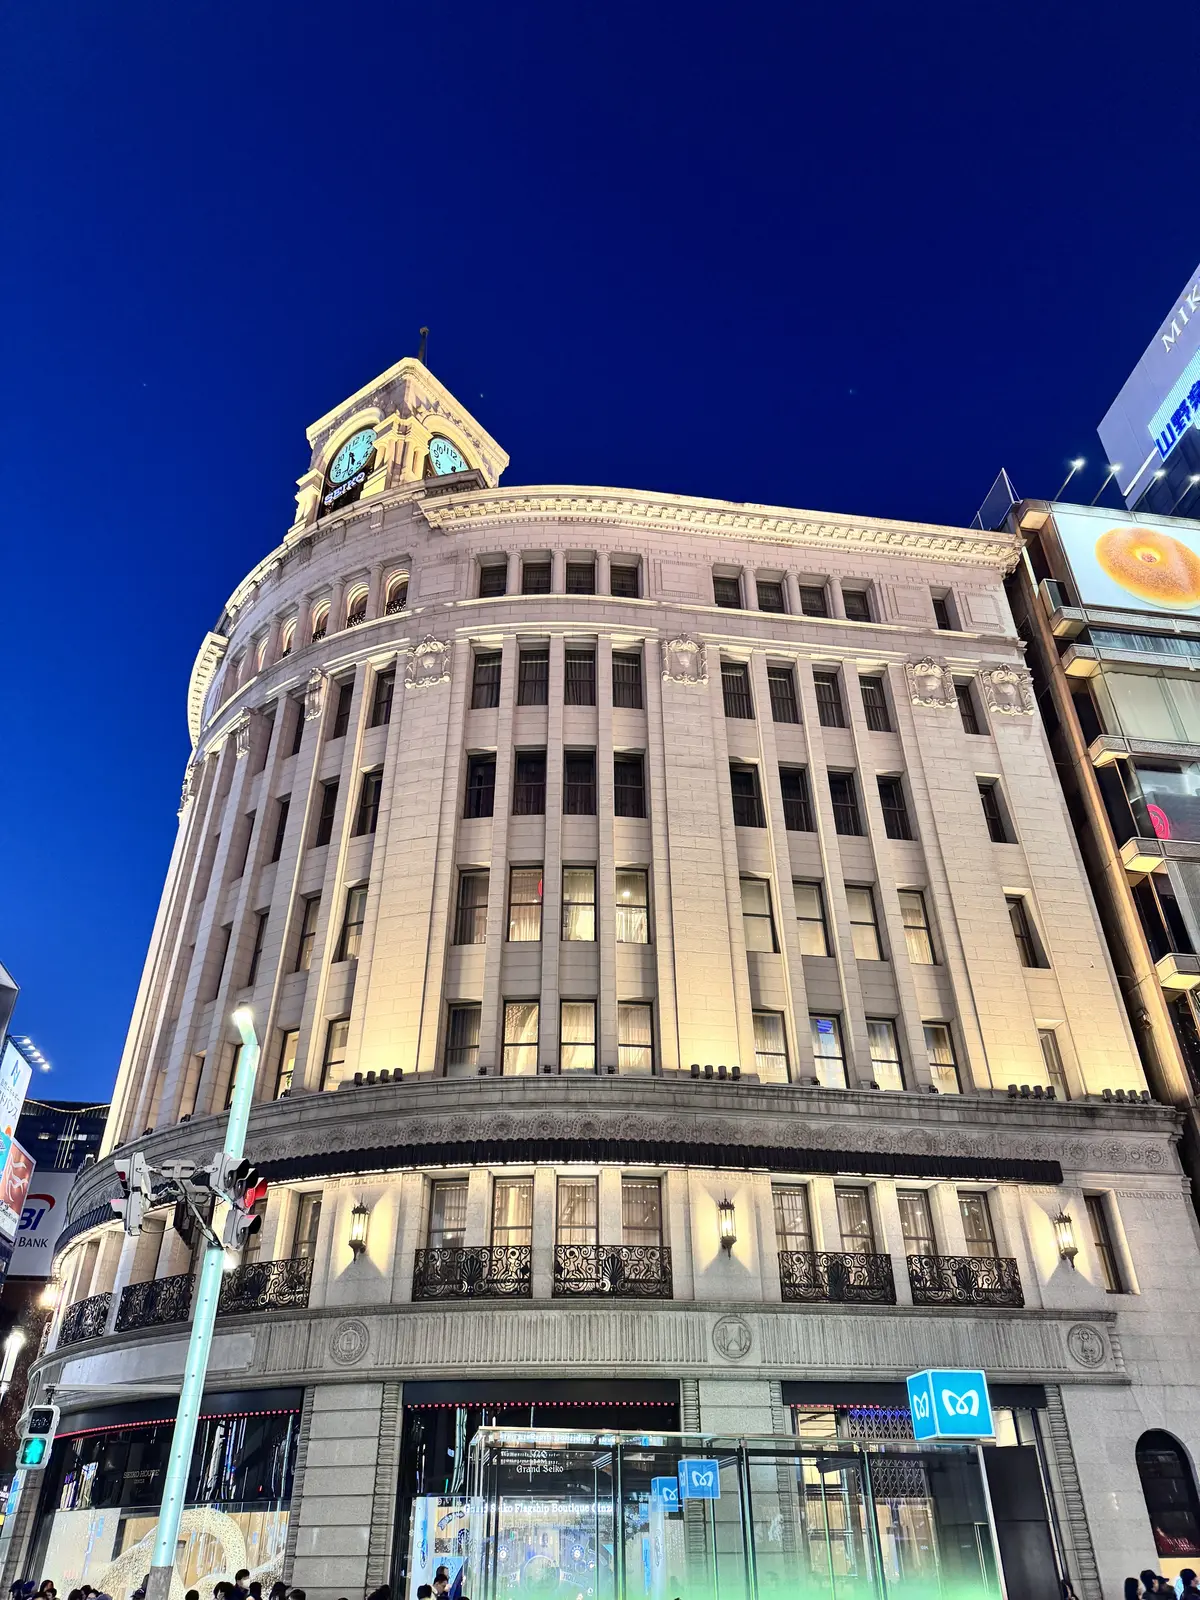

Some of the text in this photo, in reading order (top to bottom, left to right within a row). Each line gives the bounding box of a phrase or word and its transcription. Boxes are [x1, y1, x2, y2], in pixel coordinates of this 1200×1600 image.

[352, 436, 360, 446] 12
[324, 472, 366, 506] SEIKO
[0, 1090, 18, 1120] ドバンス
[18, 1236, 48, 1248] BANK
[516, 1465, 564, 1473] Grand Seiko
[490, 1503, 513, 1513] Siko
[514, 1503, 549, 1515] Flagship
[552, 1503, 590, 1515] Boutique
